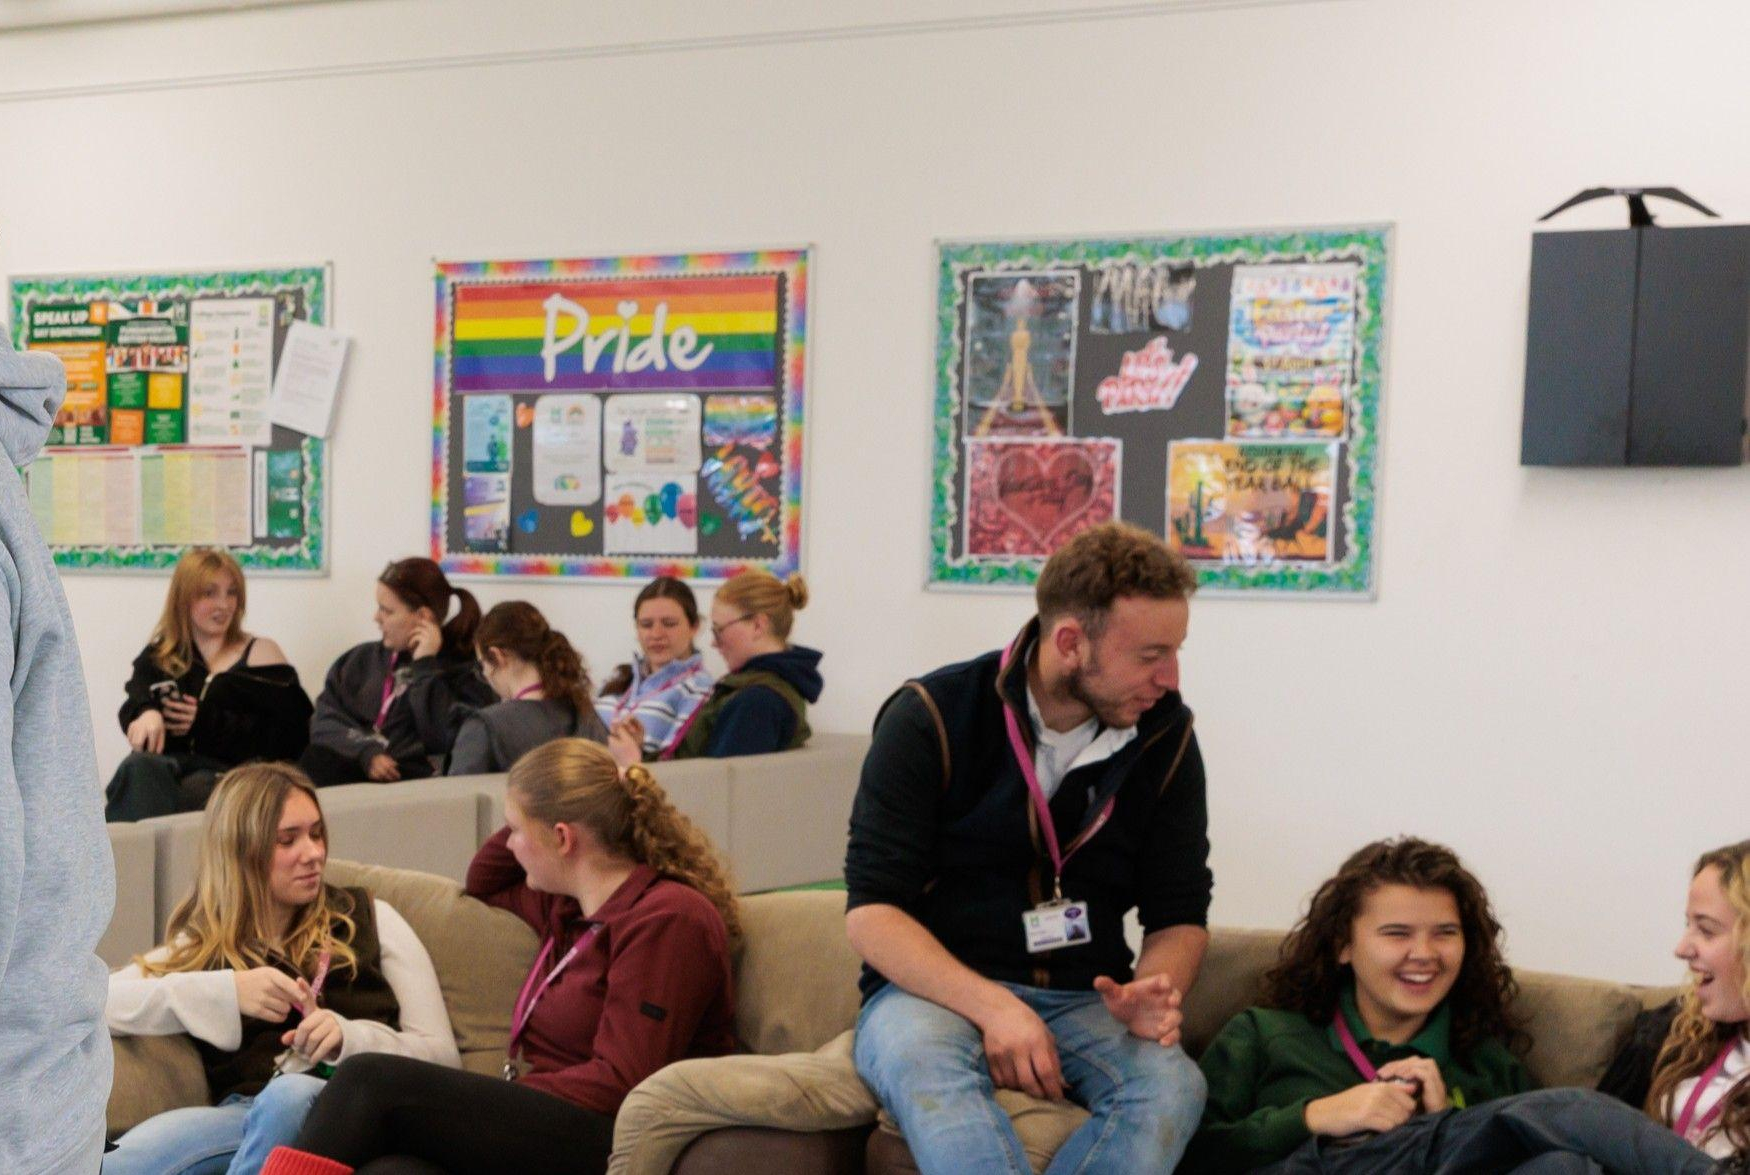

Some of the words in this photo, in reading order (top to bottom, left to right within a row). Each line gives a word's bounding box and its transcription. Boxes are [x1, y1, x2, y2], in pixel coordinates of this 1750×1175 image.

[33, 310, 70, 325] SPEAK
[71, 309, 89, 324] UP
[541, 293, 714, 383] Pride
